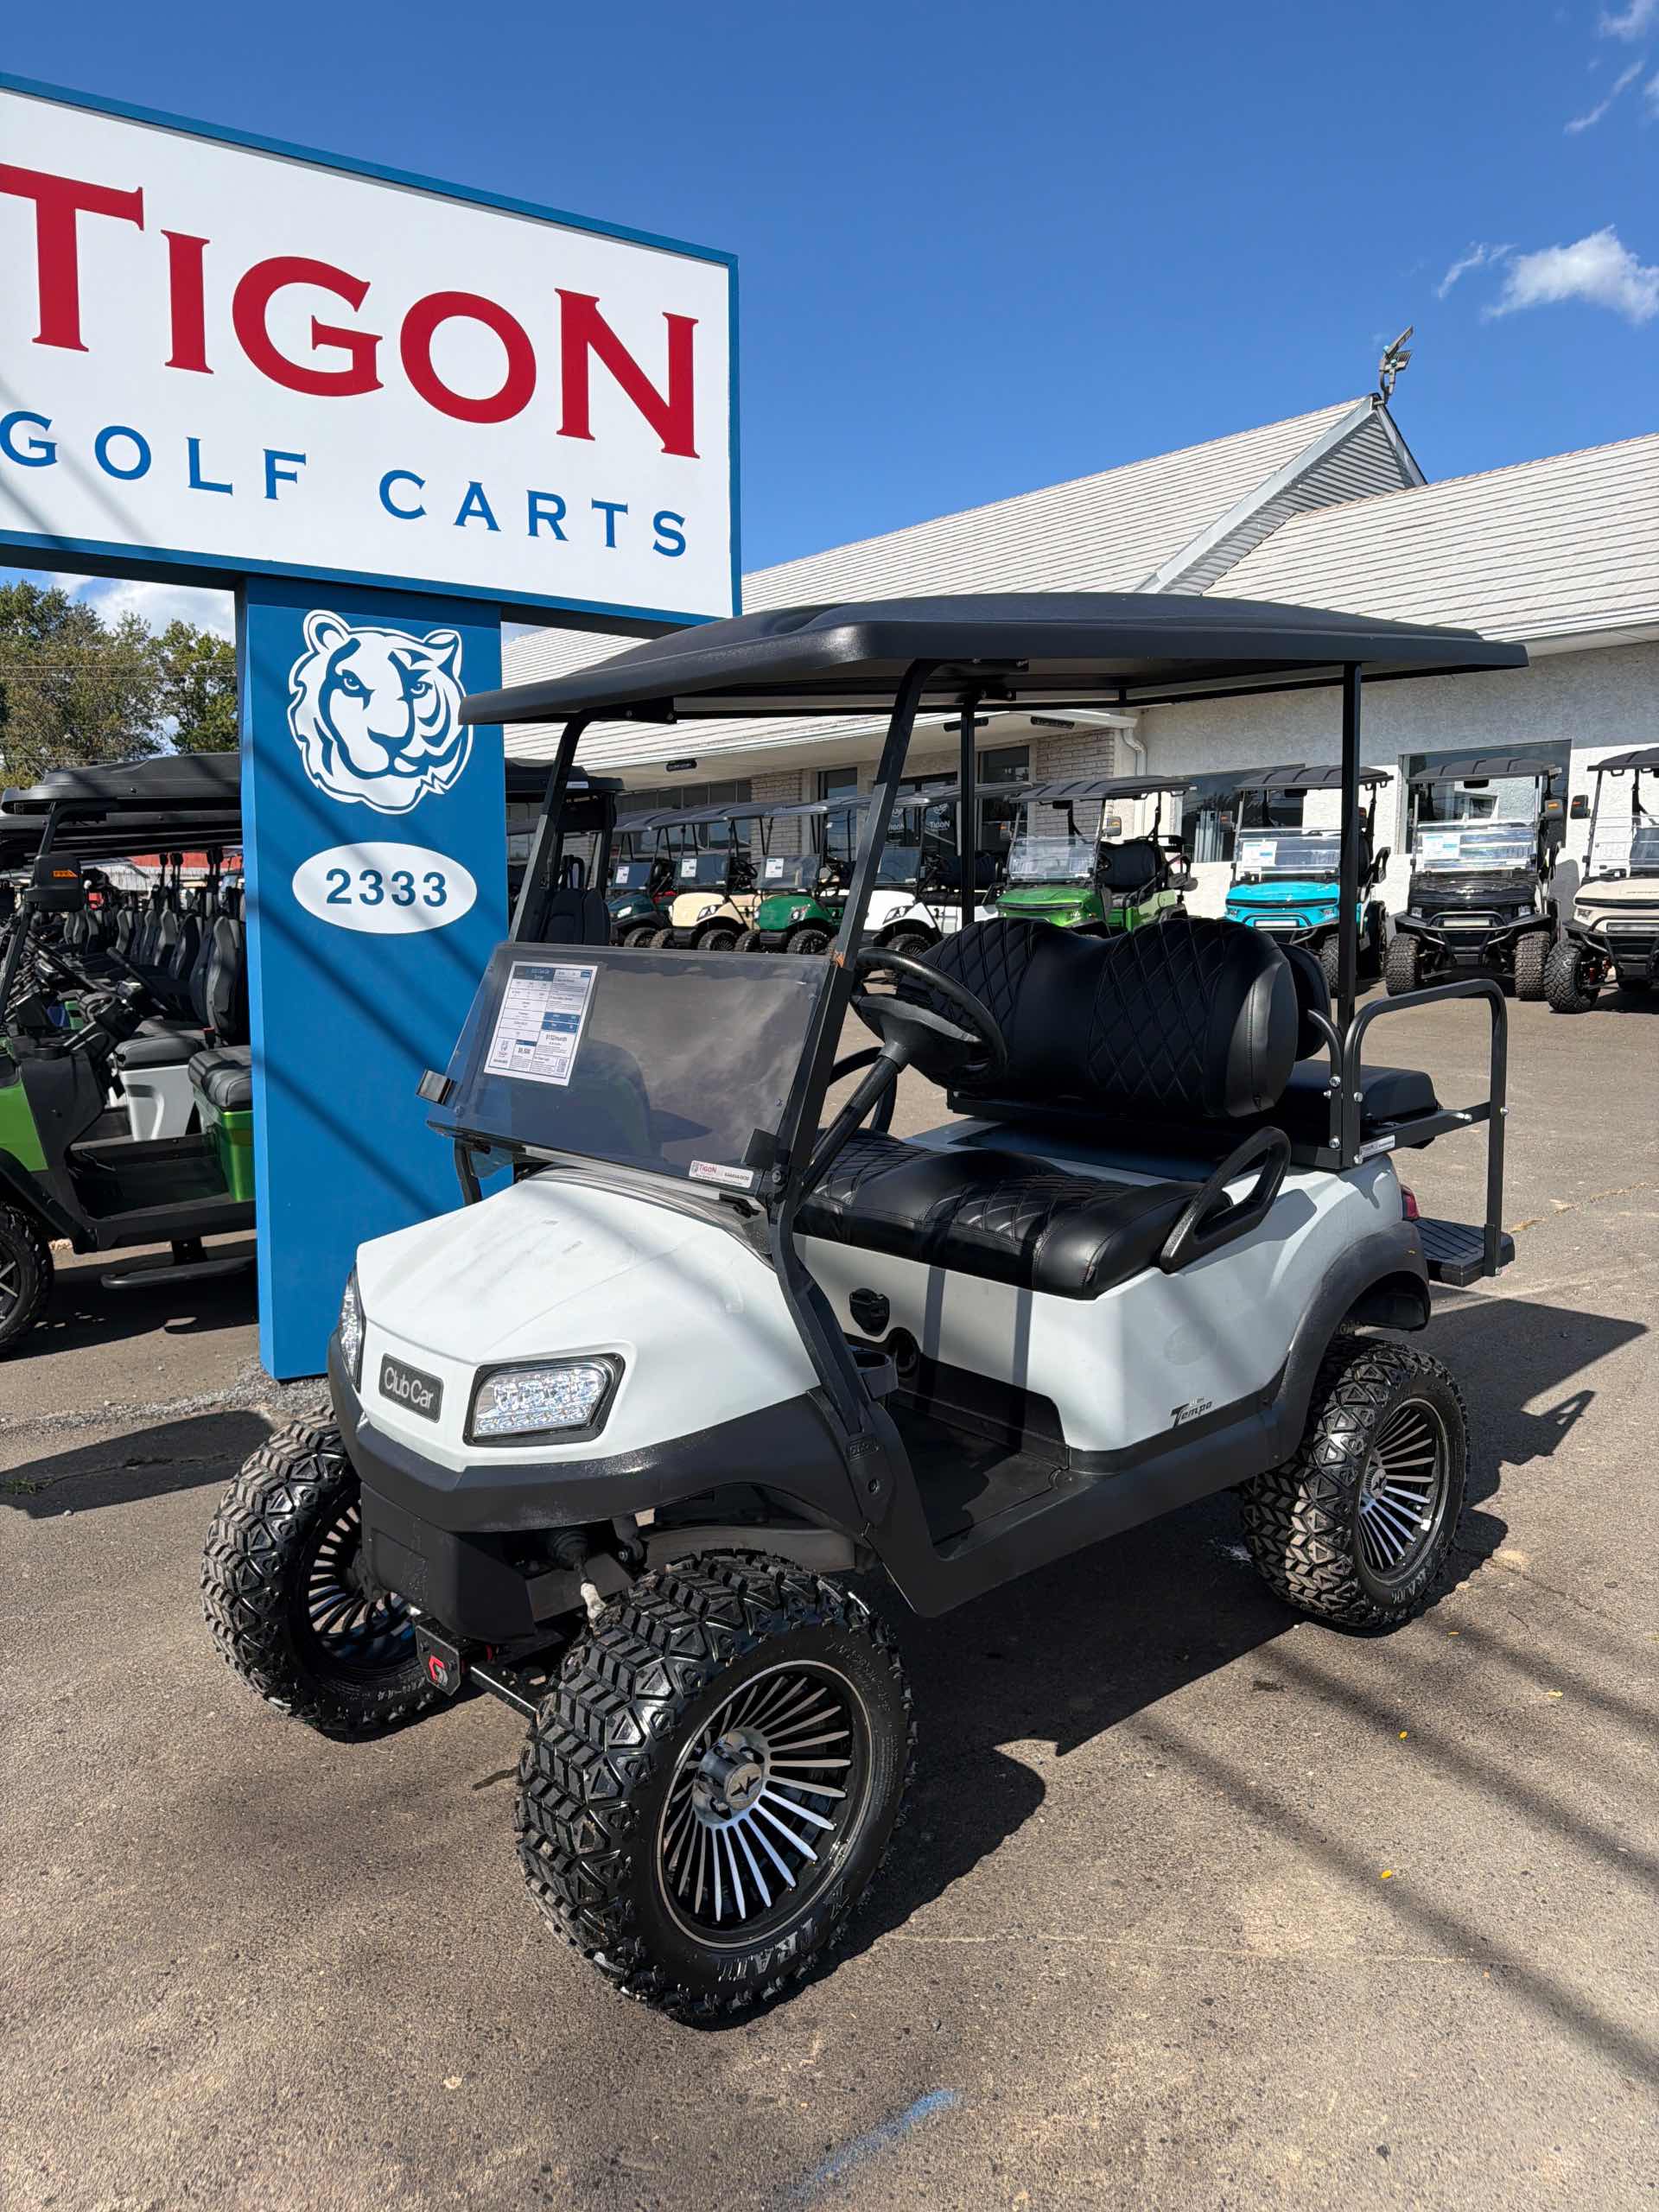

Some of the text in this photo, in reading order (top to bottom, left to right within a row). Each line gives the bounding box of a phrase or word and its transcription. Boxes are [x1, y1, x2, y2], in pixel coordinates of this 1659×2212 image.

[0, 164, 700, 458] TIGON
[0, 411, 686, 557] GOLF CARTS
[326, 868, 448, 907] 2333
[1170, 1401, 1212, 1428] Tempo
